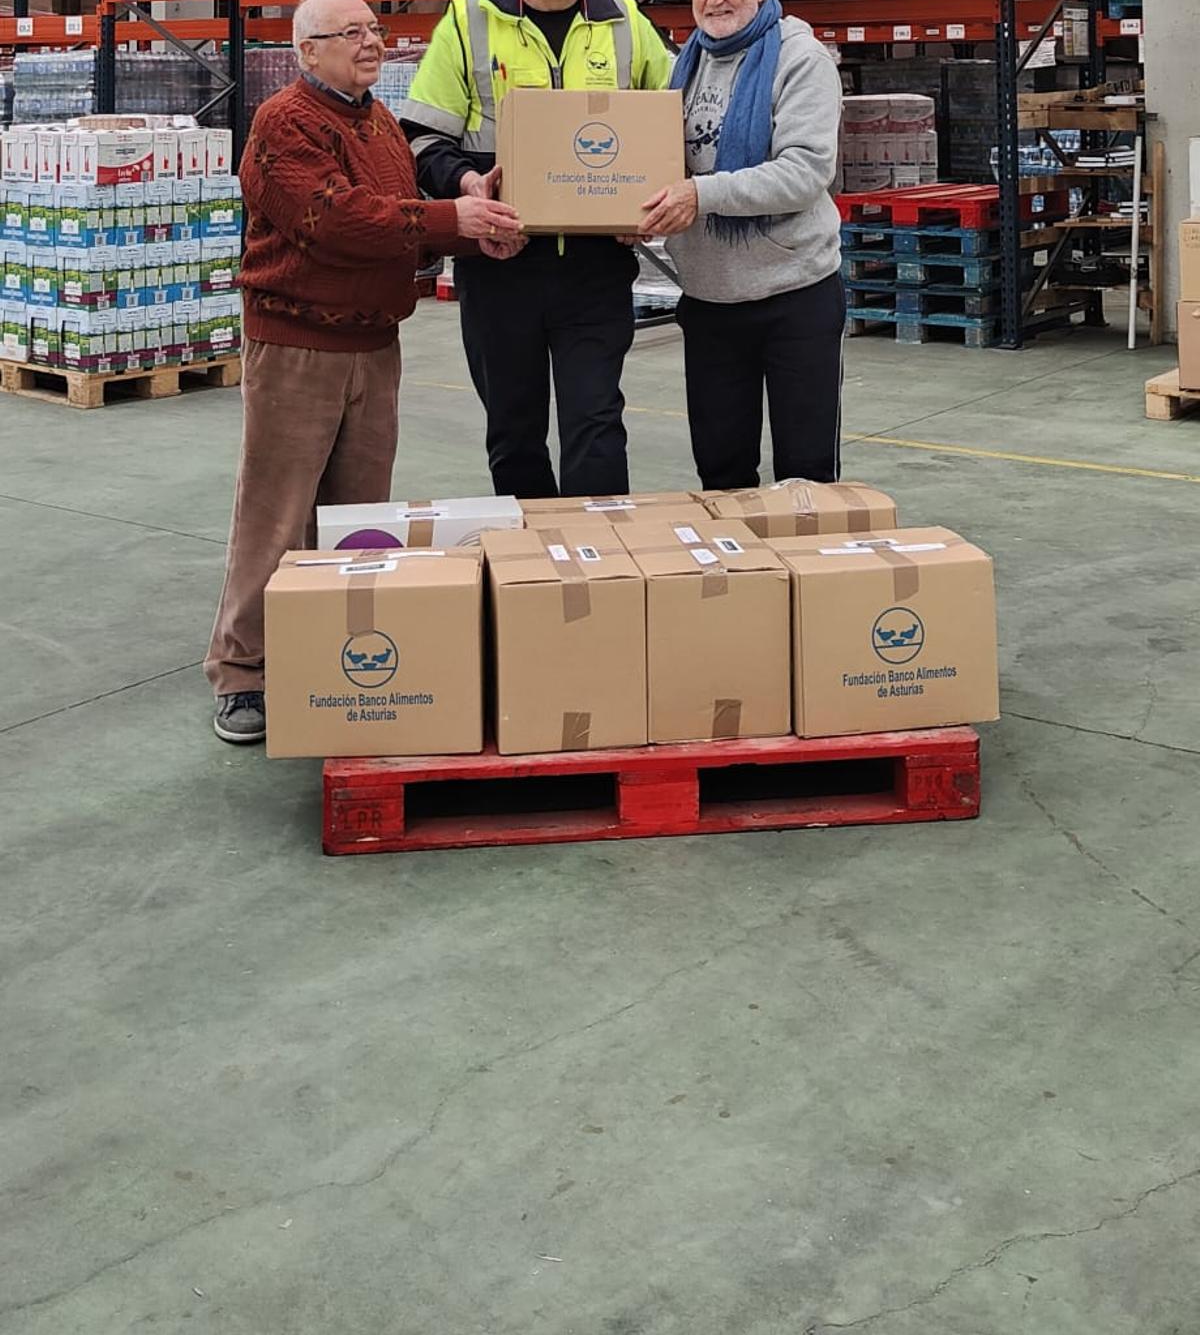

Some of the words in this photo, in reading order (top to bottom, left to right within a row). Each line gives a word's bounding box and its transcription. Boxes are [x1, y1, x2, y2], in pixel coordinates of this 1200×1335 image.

[843, 672, 886, 687] Fundación
[888, 670, 915, 683] Banco
[916, 666, 957, 681] Alimentos
[877, 685, 888, 698] de
[889, 683, 924, 697] Asturias
[309, 694, 357, 708] Fundación
[358, 694, 387, 707] Banco
[389, 692, 434, 705] Alimentos
[346, 709, 358, 722] de
[359, 708, 397, 721] Asturias
